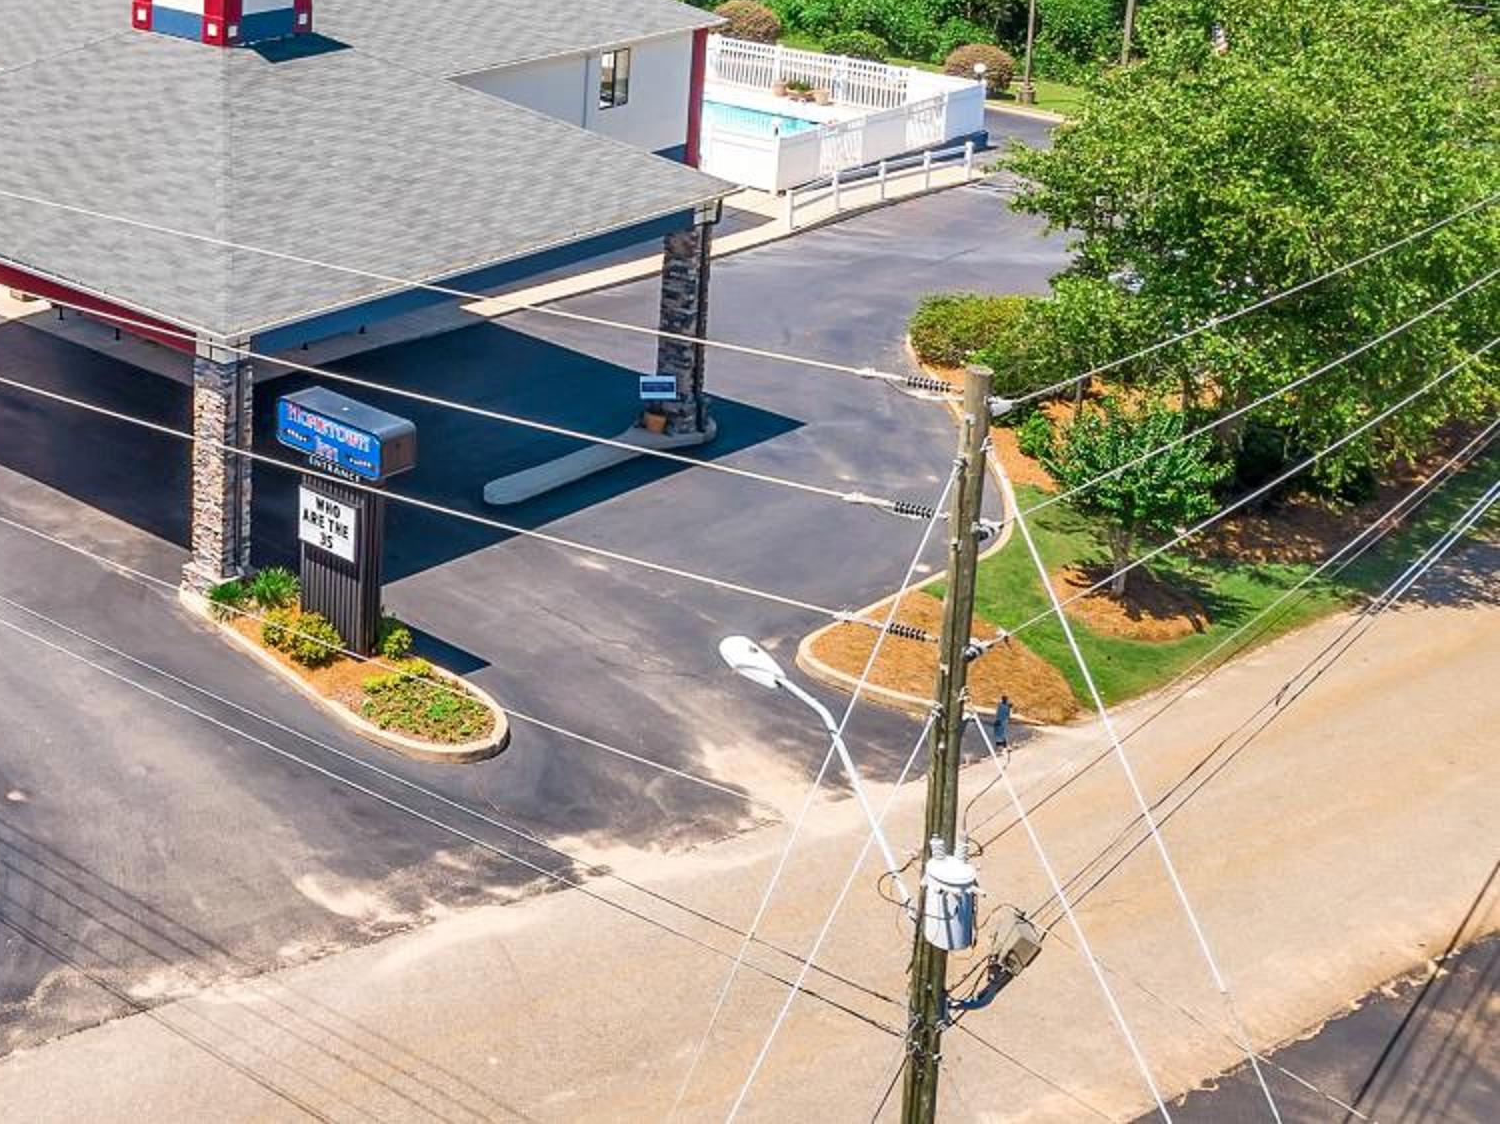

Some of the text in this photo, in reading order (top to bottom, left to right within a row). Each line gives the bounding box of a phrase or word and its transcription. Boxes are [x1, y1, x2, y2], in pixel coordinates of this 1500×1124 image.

[315, 496, 341, 519] WHO
[303, 508, 349, 540] ARE THE
